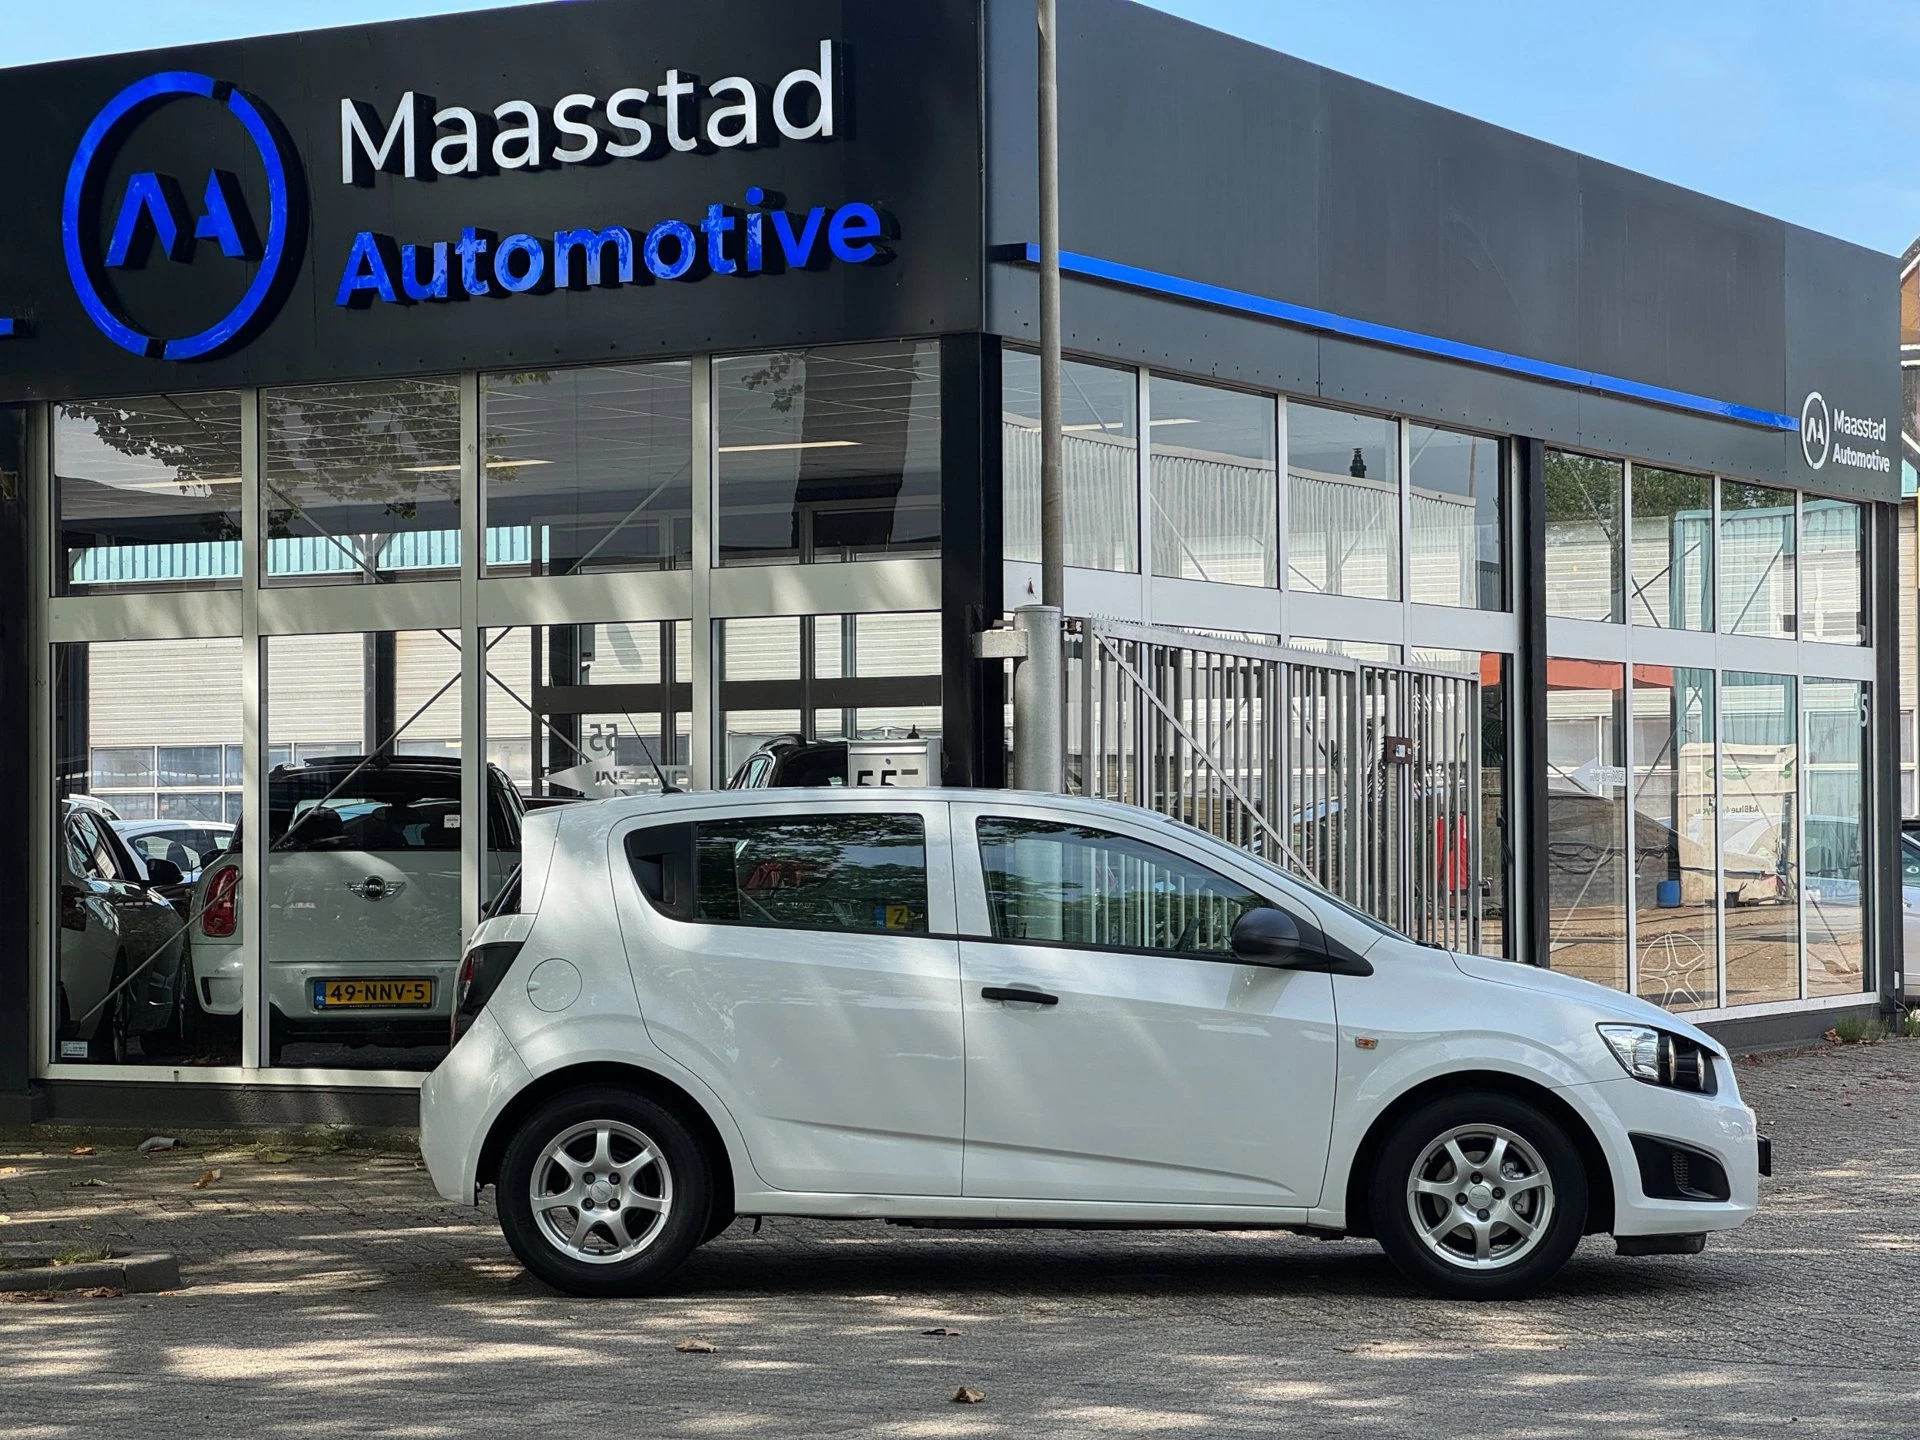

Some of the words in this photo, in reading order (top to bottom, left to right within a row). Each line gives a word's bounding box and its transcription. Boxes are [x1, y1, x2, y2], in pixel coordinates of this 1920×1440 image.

[341, 39, 835, 185] Maasstad
[335, 187, 882, 308] Automotive
[1833, 408, 1887, 442] Maasstad
[1832, 443, 1890, 473] Automotive
[330, 984, 425, 1002] 49-NNV-5
